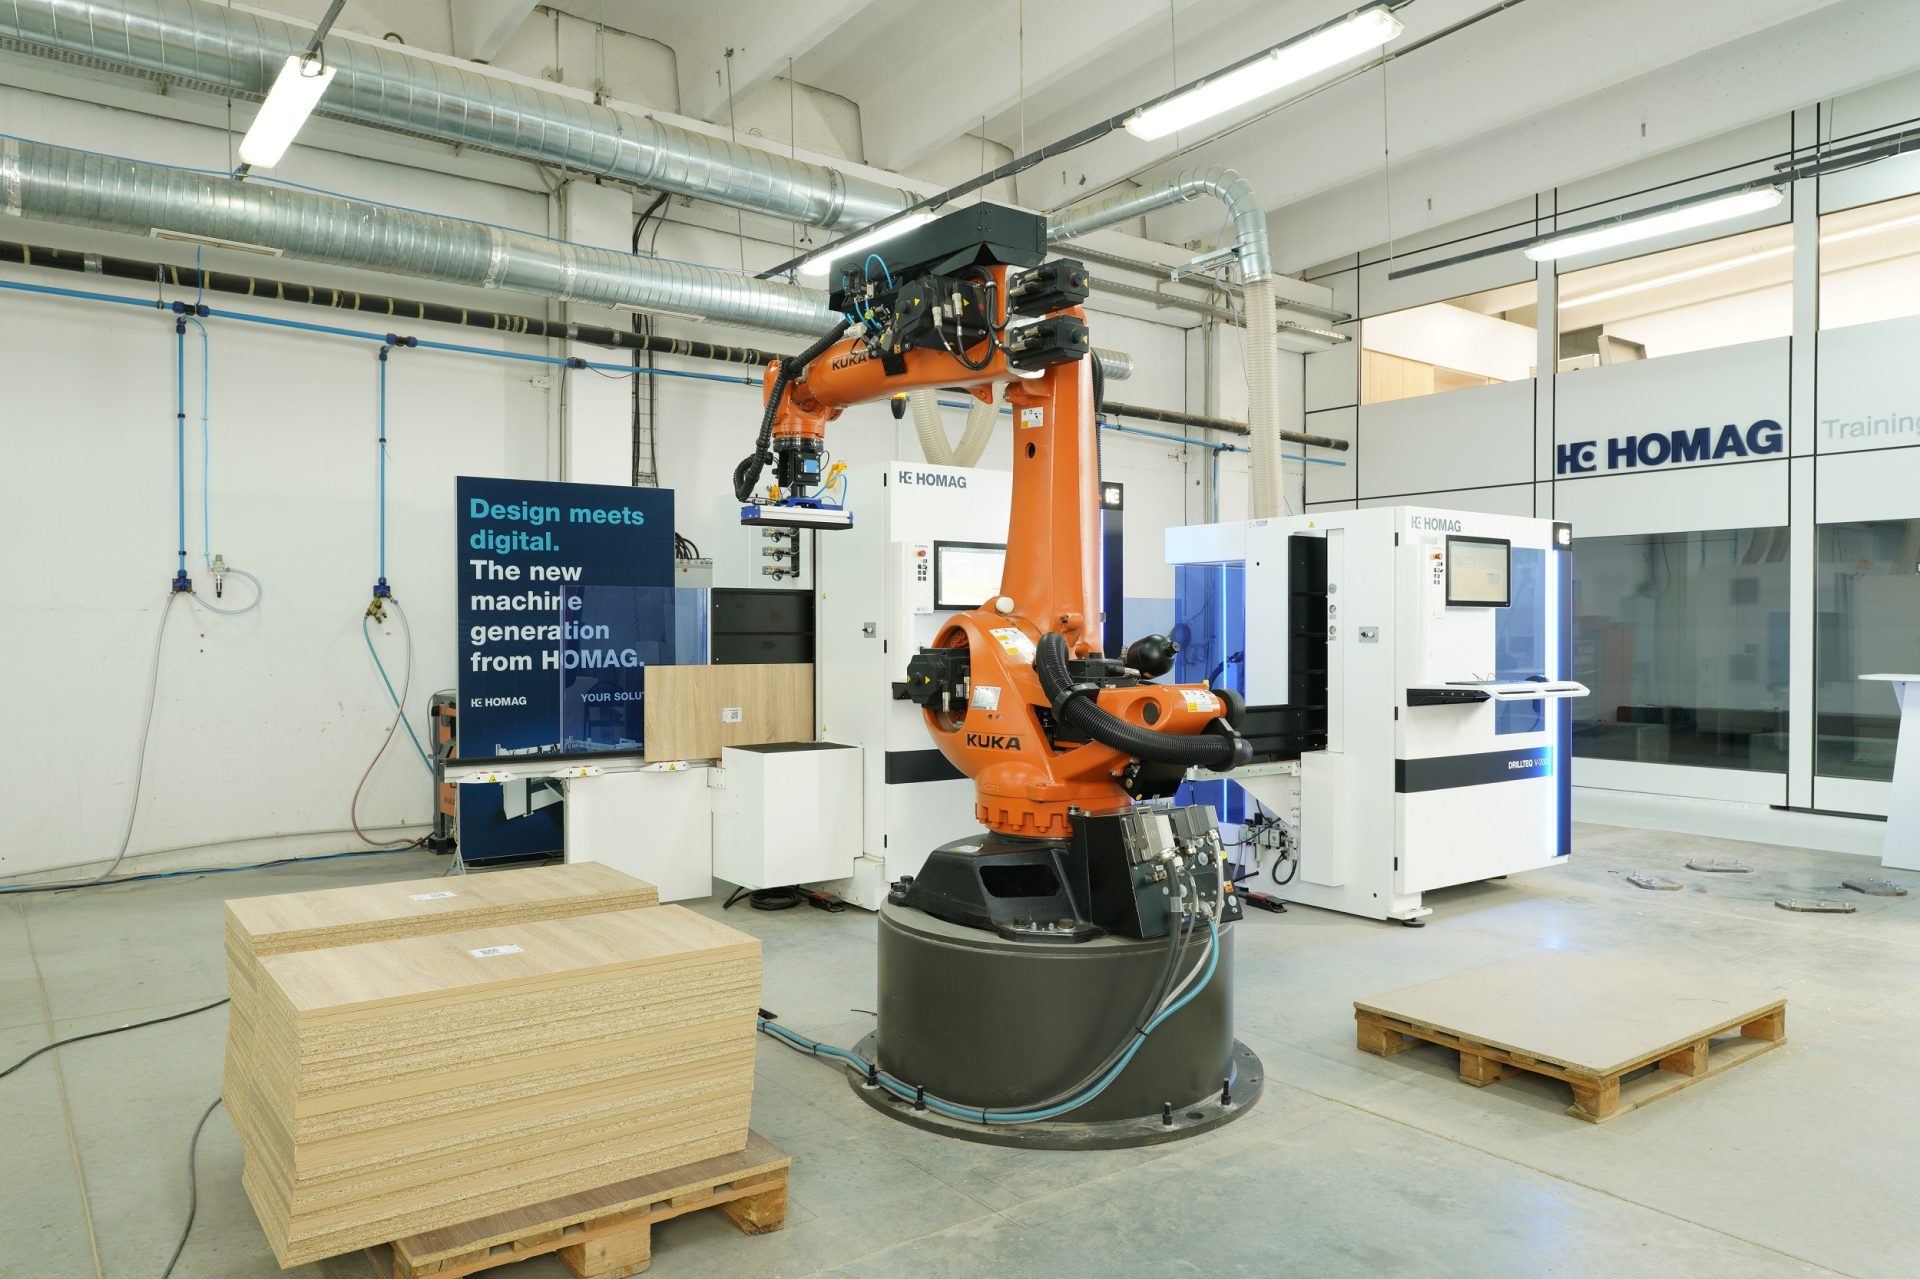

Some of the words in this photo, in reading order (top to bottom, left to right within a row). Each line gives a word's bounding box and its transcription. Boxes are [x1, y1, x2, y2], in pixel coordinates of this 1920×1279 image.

[832, 354, 867, 370] KUKA
[1607, 419, 1783, 470] HOMAG
[916, 472, 967, 489] HOMAG
[470, 498, 560, 525] Design
[569, 507, 644, 525] meets
[1424, 517, 1462, 532] HOMAG
[470, 529, 560, 554] digital.
[470, 559, 521, 580] The
[530, 565, 582, 581] new
[471, 591, 582, 611] machine
[470, 621, 610, 646] generation
[470, 652, 533, 671] from
[542, 648, 645, 670] HOMAG.
[485, 697, 527, 707] HOMAG
[581, 692, 611, 703] YOUR
[967, 733, 1021, 750] KUKA
[1508, 759, 1533, 769] DRILLTEQ
